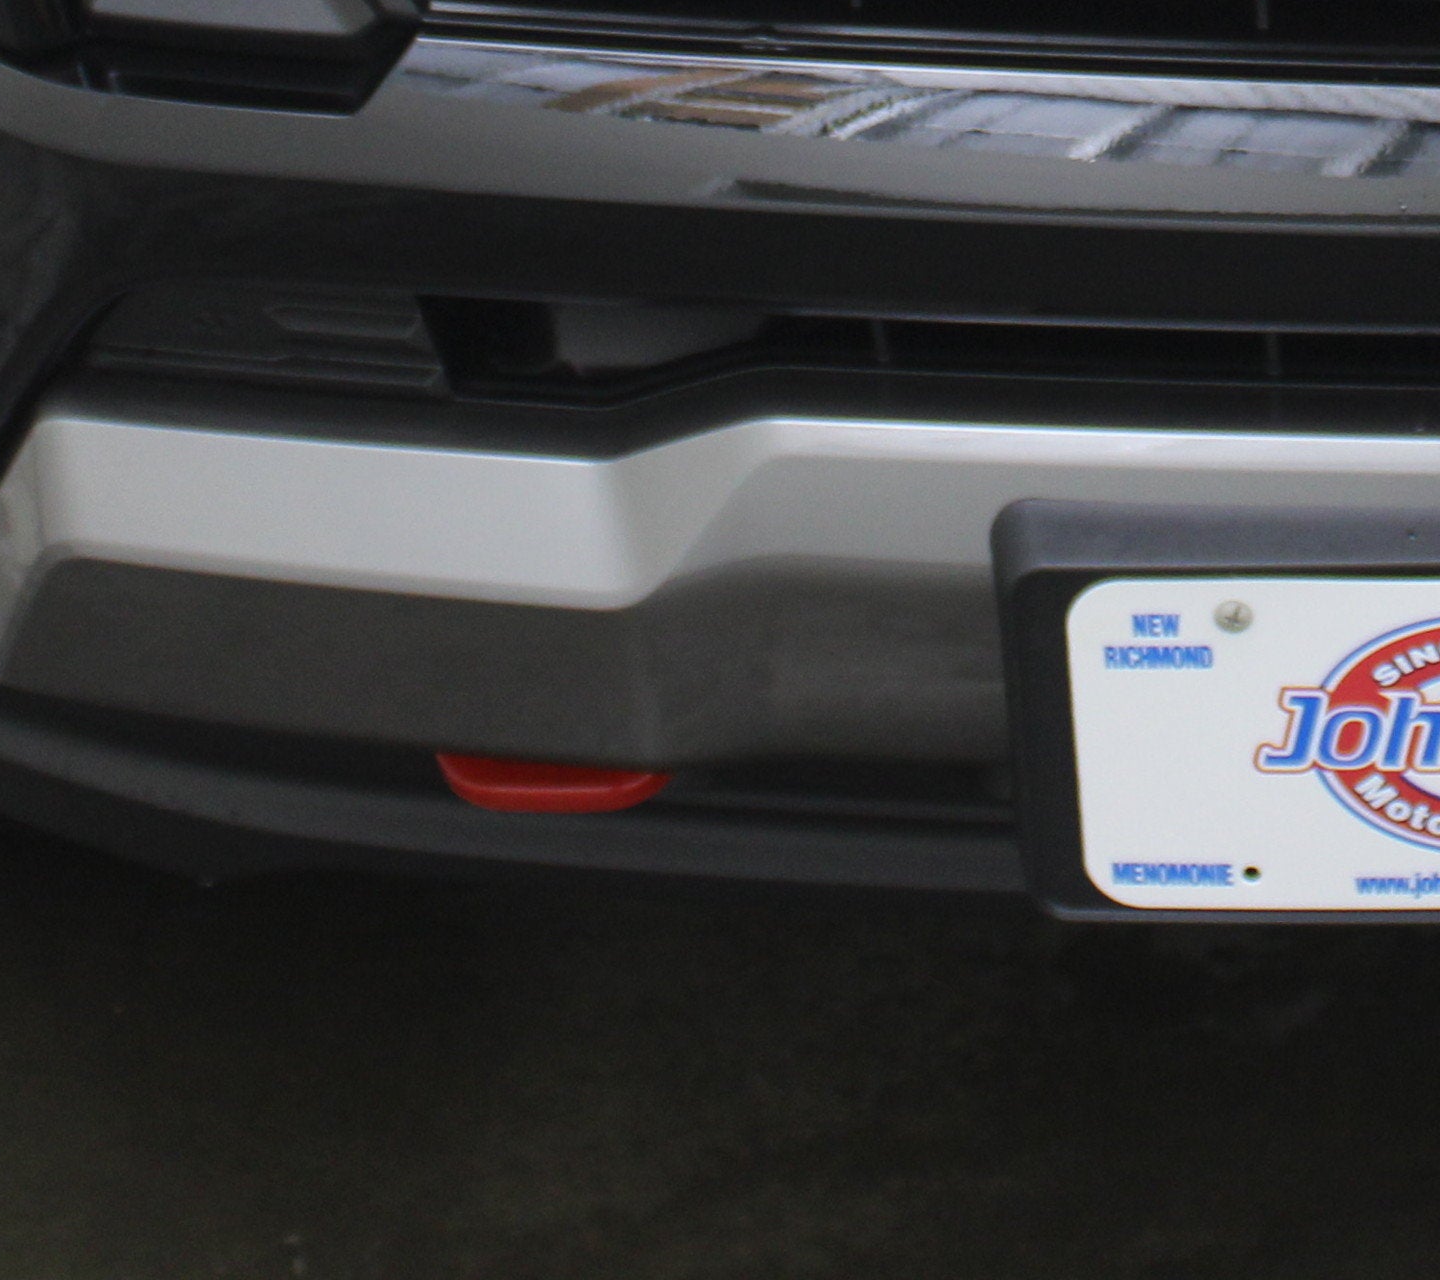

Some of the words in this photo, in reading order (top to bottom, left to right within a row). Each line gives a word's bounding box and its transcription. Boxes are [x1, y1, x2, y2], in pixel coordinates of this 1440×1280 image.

[1131, 614, 1181, 637] NEW
[1104, 646, 1214, 669] RICHMOND
[1112, 862, 1234, 887] MENOMONIE
